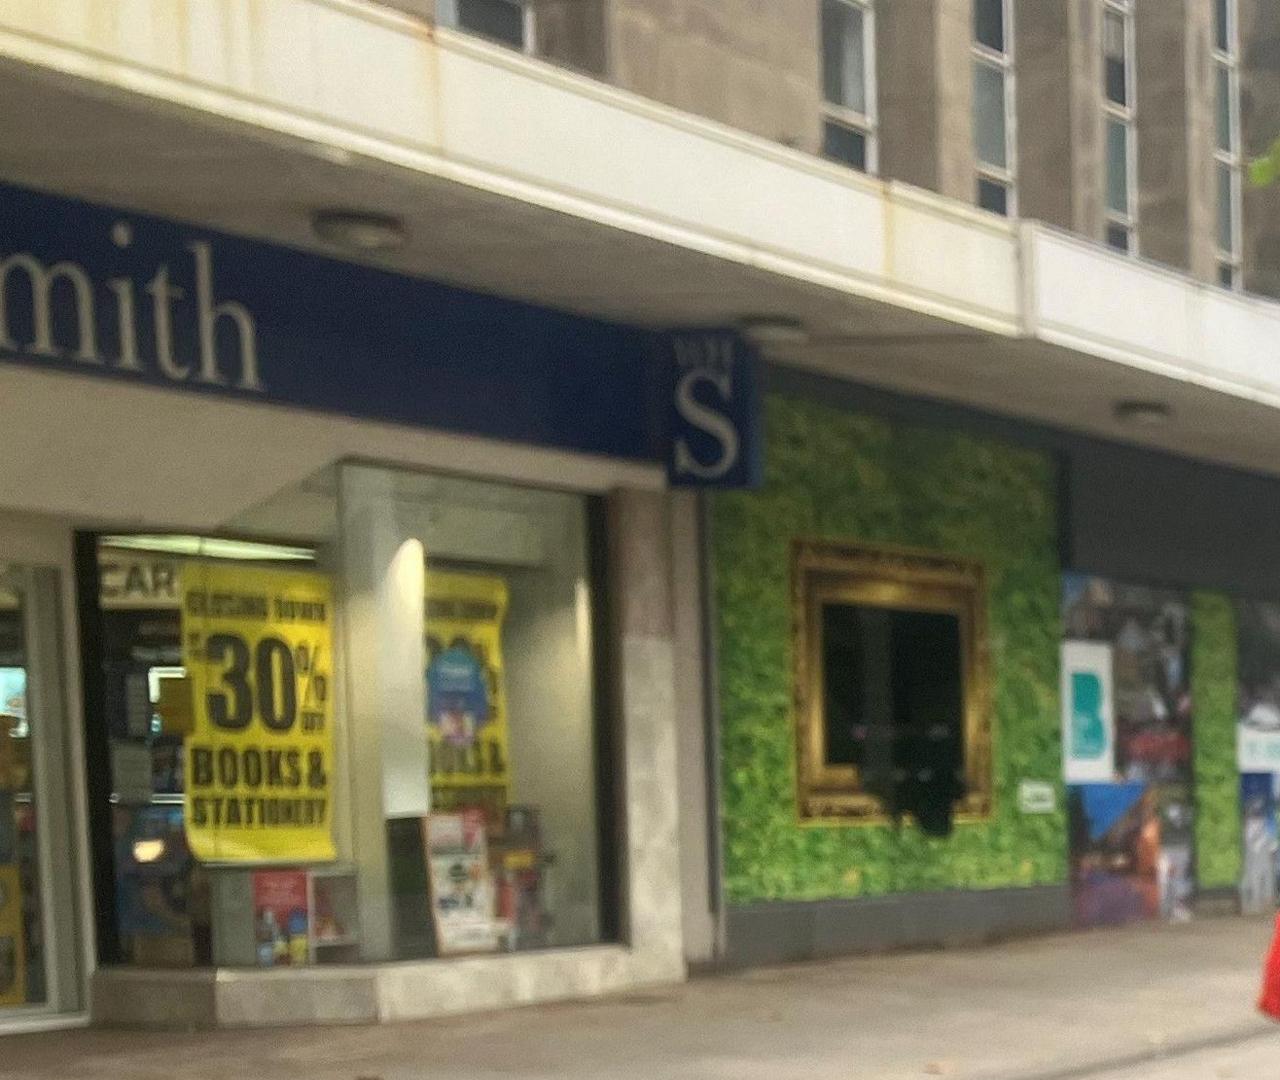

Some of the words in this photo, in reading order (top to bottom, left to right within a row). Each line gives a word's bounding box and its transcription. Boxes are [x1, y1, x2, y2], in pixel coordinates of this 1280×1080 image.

[673, 368, 738, 478] S
[191, 745, 301, 788] BOOKS
[307, 749, 327, 790] &
